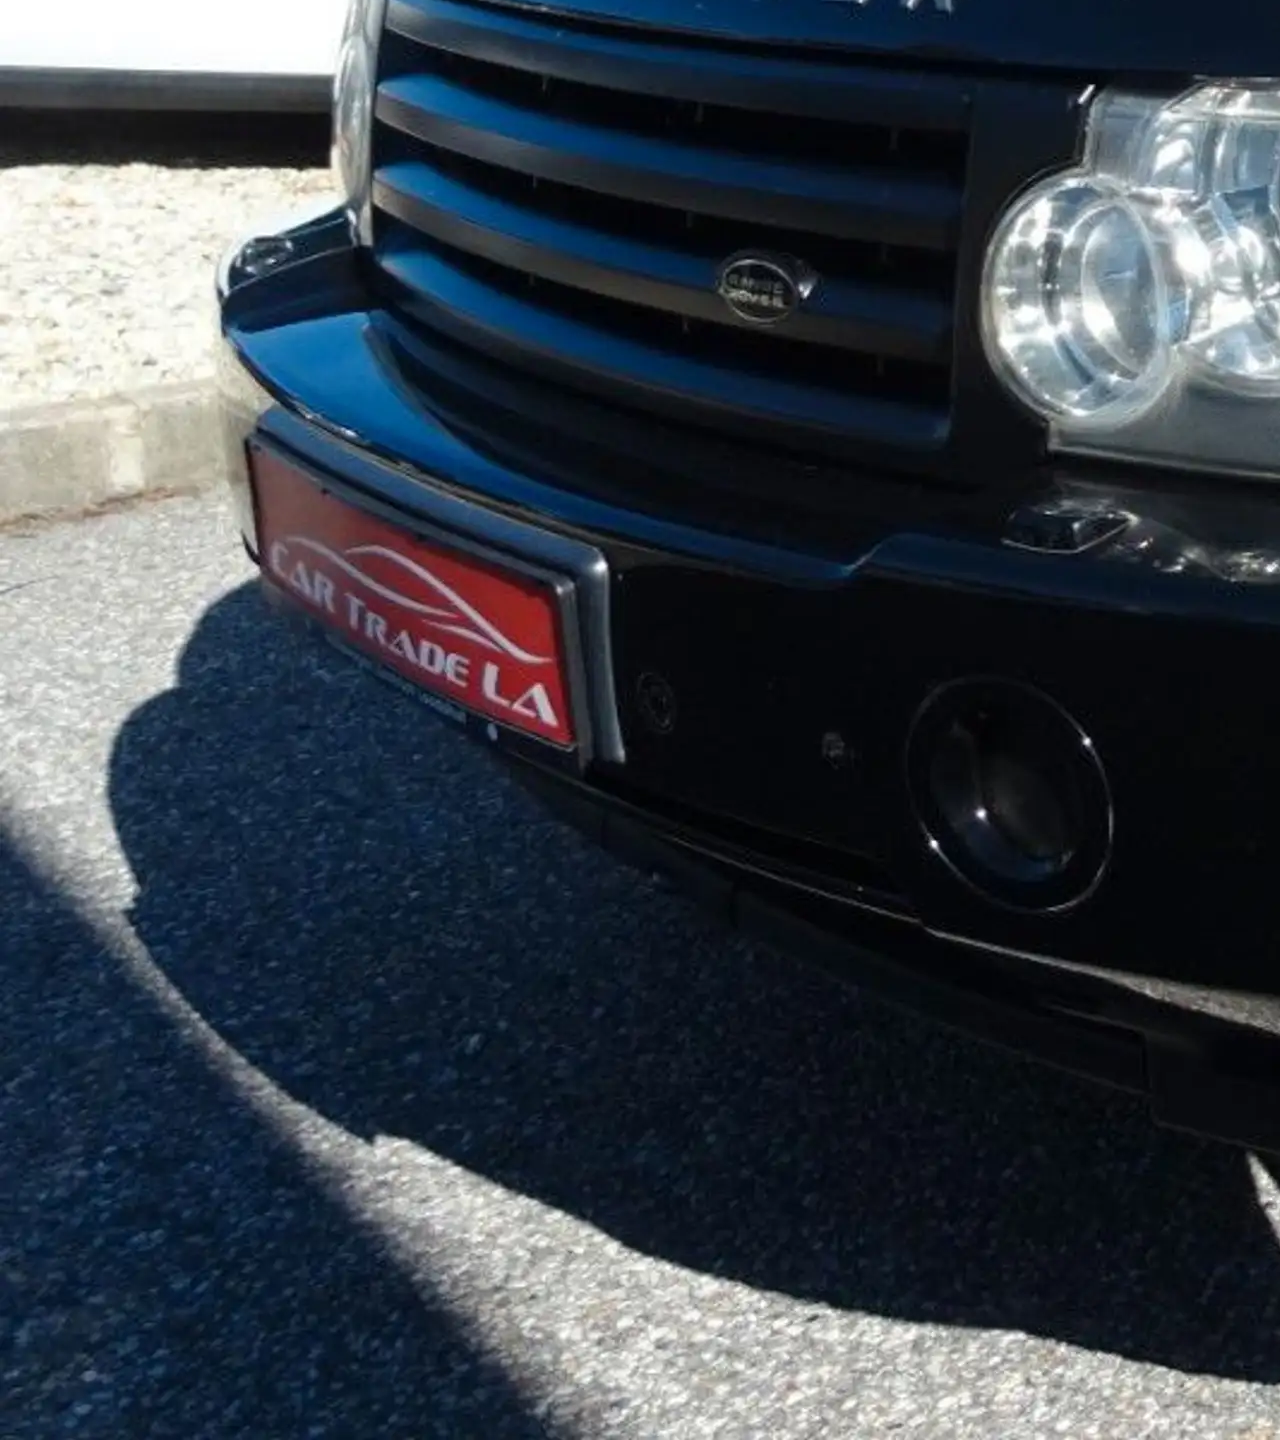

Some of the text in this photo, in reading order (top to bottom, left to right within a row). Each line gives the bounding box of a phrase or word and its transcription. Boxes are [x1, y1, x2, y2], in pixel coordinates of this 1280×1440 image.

[271, 541, 336, 614] CAR
[344, 592, 470, 688] TRADE
[481, 661, 558, 728] LA
